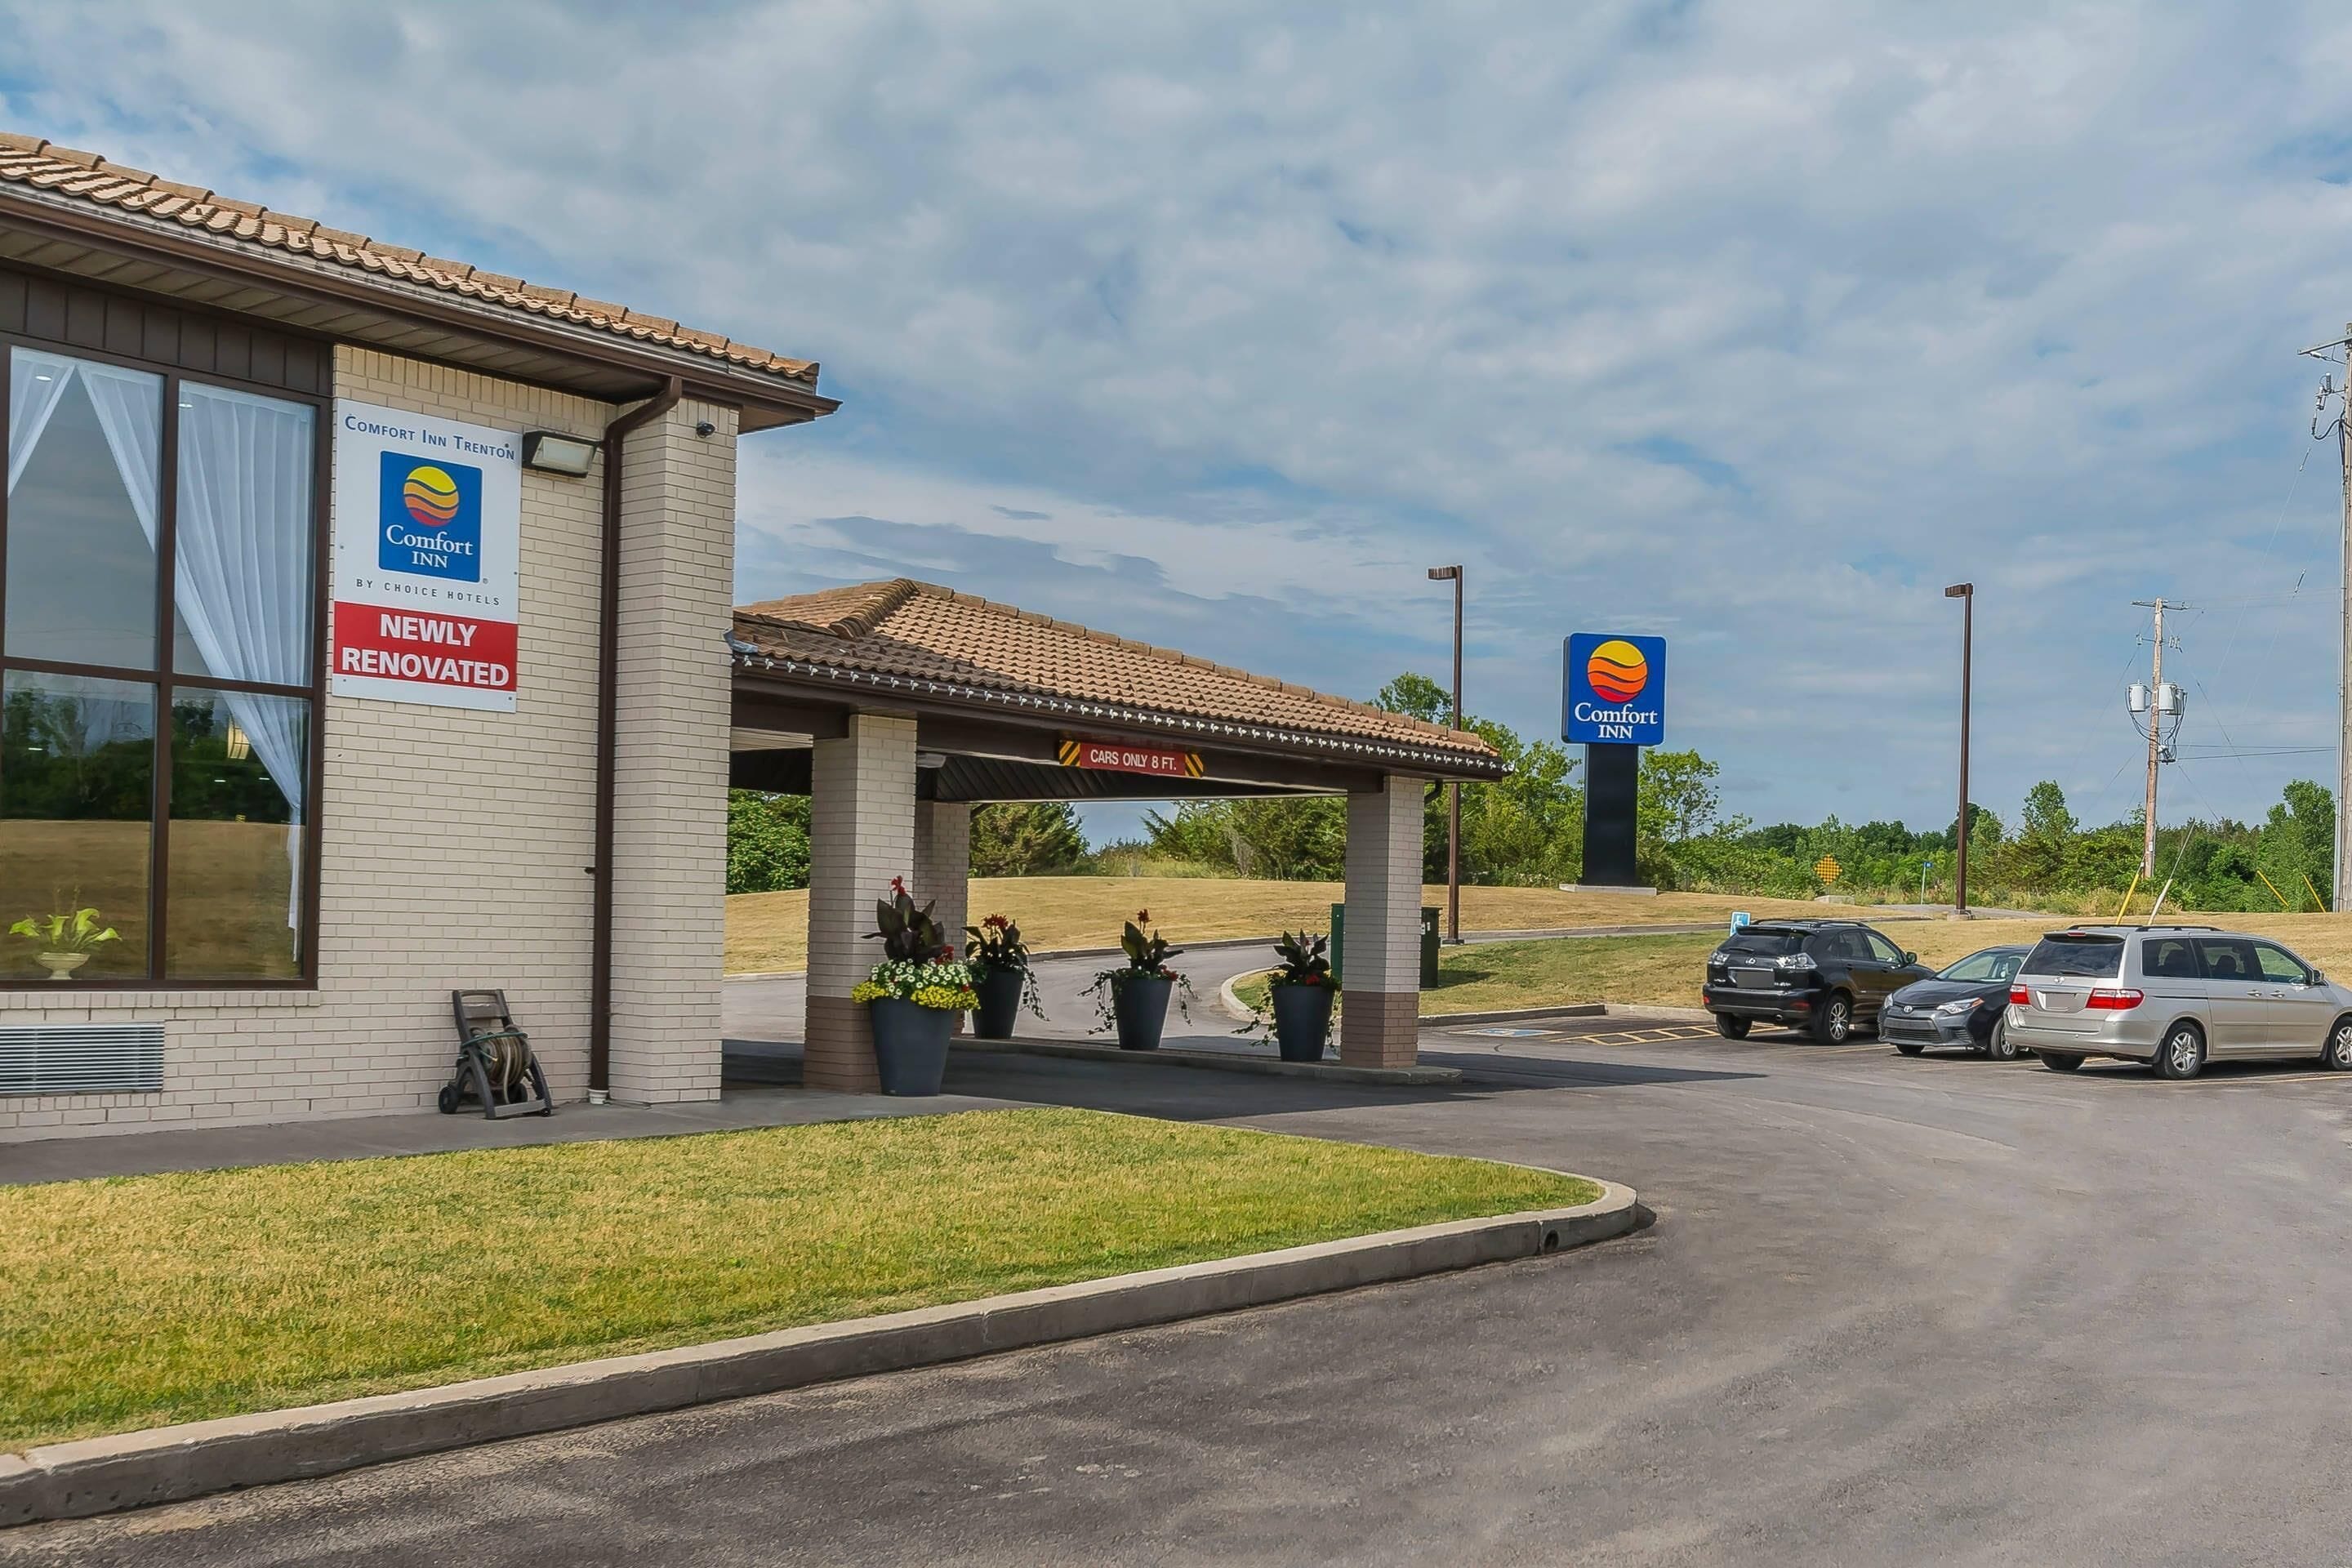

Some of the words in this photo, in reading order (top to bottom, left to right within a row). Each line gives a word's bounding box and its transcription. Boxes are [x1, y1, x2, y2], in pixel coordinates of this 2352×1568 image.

[345, 416, 416, 440] COMFORT
[422, 430, 447, 447] INN
[453, 435, 515, 460] TRENTON
[386, 524, 474, 555] Comfort
[412, 550, 448, 568] INN
[356, 578, 372, 588] BY
[384, 582, 438, 597] CHOICE
[448, 591, 500, 606] HOTELS
[380, 613, 478, 647] NEWLY
[341, 647, 510, 686] RENOVATED
[1575, 702, 1658, 724] Comfort
[1597, 724, 1633, 739] INN
[1090, 749, 1119, 765] CARS
[1122, 752, 1147, 768] ONLY
[1152, 755, 1159, 769] 8
[1161, 756, 1177, 770] FT.
